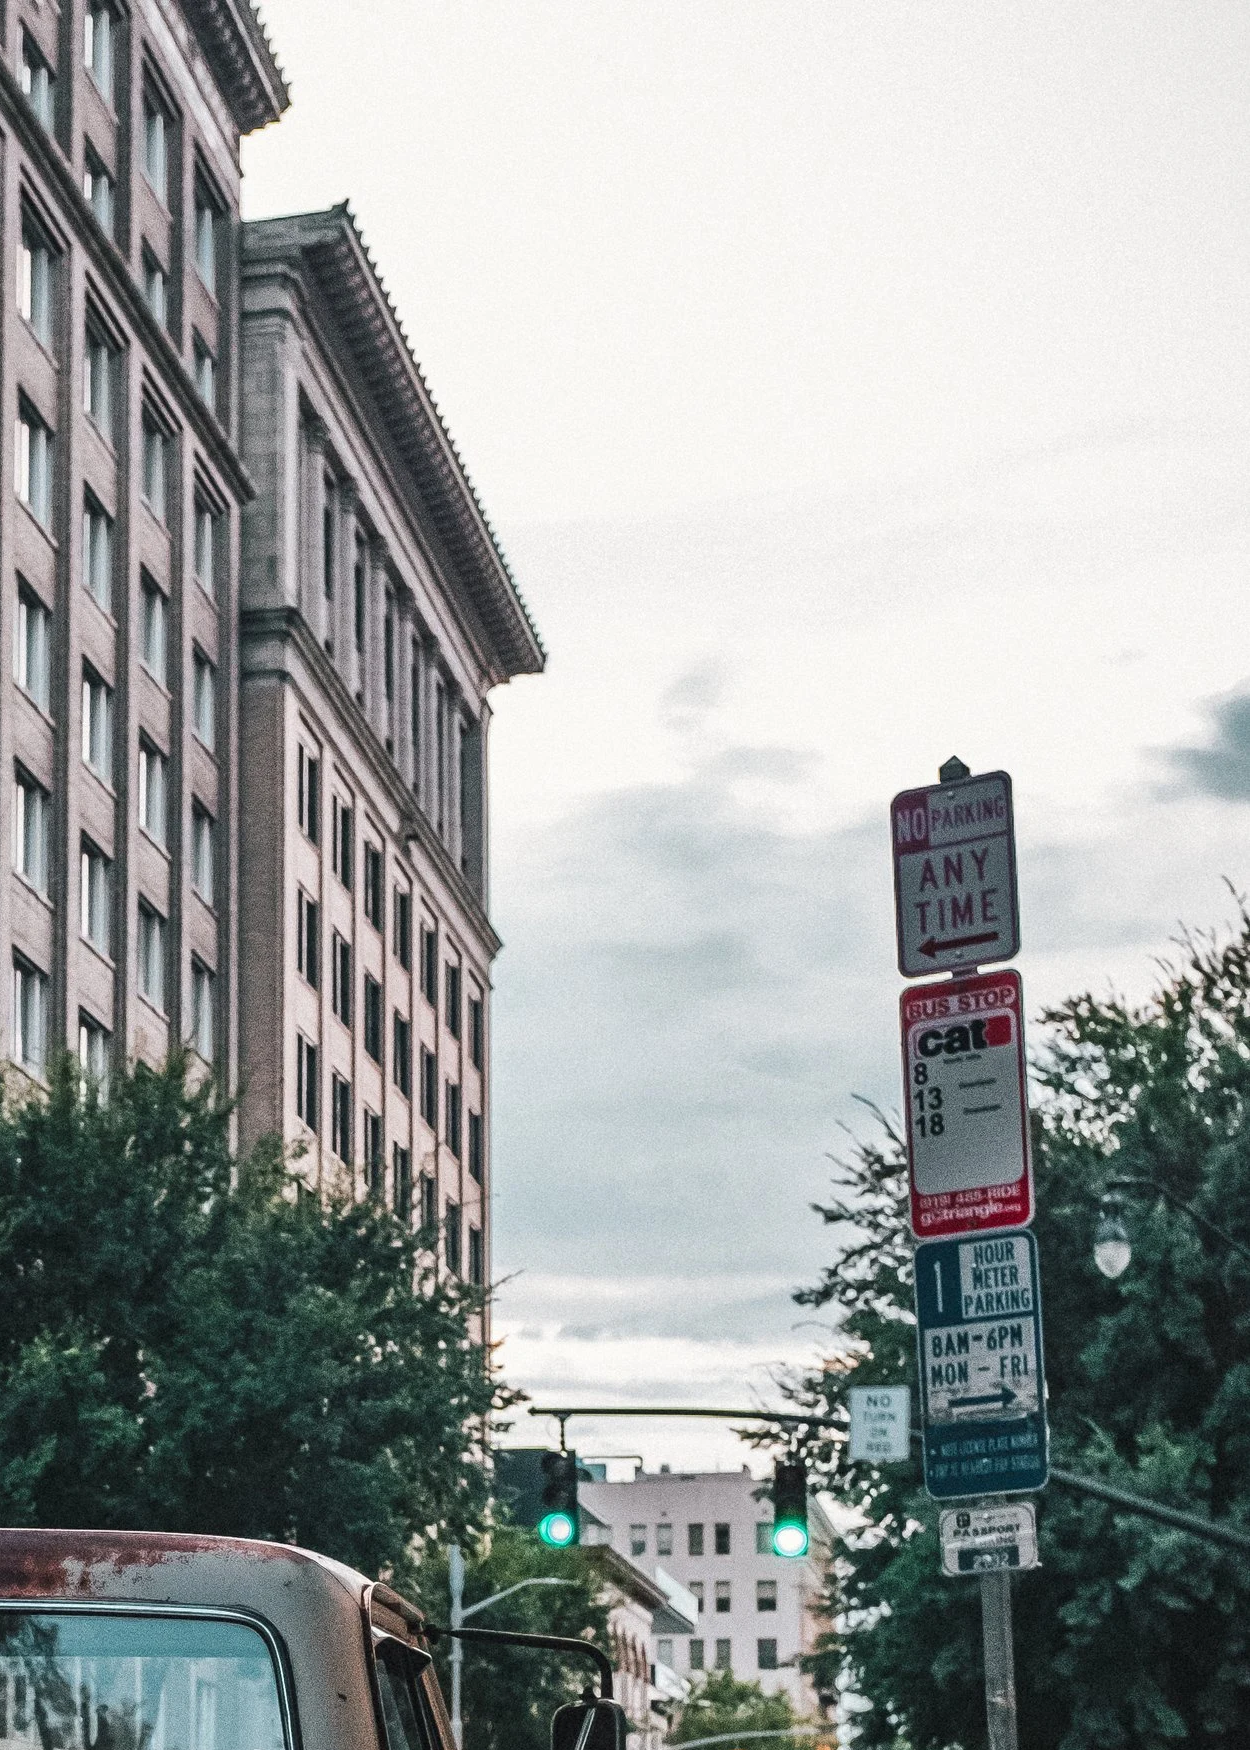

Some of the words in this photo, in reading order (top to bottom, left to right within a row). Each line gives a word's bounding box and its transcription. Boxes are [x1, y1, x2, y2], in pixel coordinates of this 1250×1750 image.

[897, 808, 927, 843] NO
[931, 797, 1006, 831] PARKING
[919, 847, 989, 893] ANY
[916, 888, 998, 935] TIME
[907, 999, 950, 1020] BUS
[957, 985, 1013, 1012] STOP
[914, 1062, 928, 1085] 8
[914, 1086, 942, 1112] 13
[915, 1112, 945, 1138] 18
[972, 1241, 1016, 1267] HOUR
[934, 1260, 944, 1313] 1
[972, 1265, 1019, 1290] METER
[964, 1288, 1031, 1317] PARKING
[931, 1360, 969, 1388] MON
[1000, 1354, 1029, 1379] FRI
[866, 1394, 891, 1408] NO
[863, 1411, 896, 1423] TURN
[952, 1522, 1021, 1538] PASSPORT
